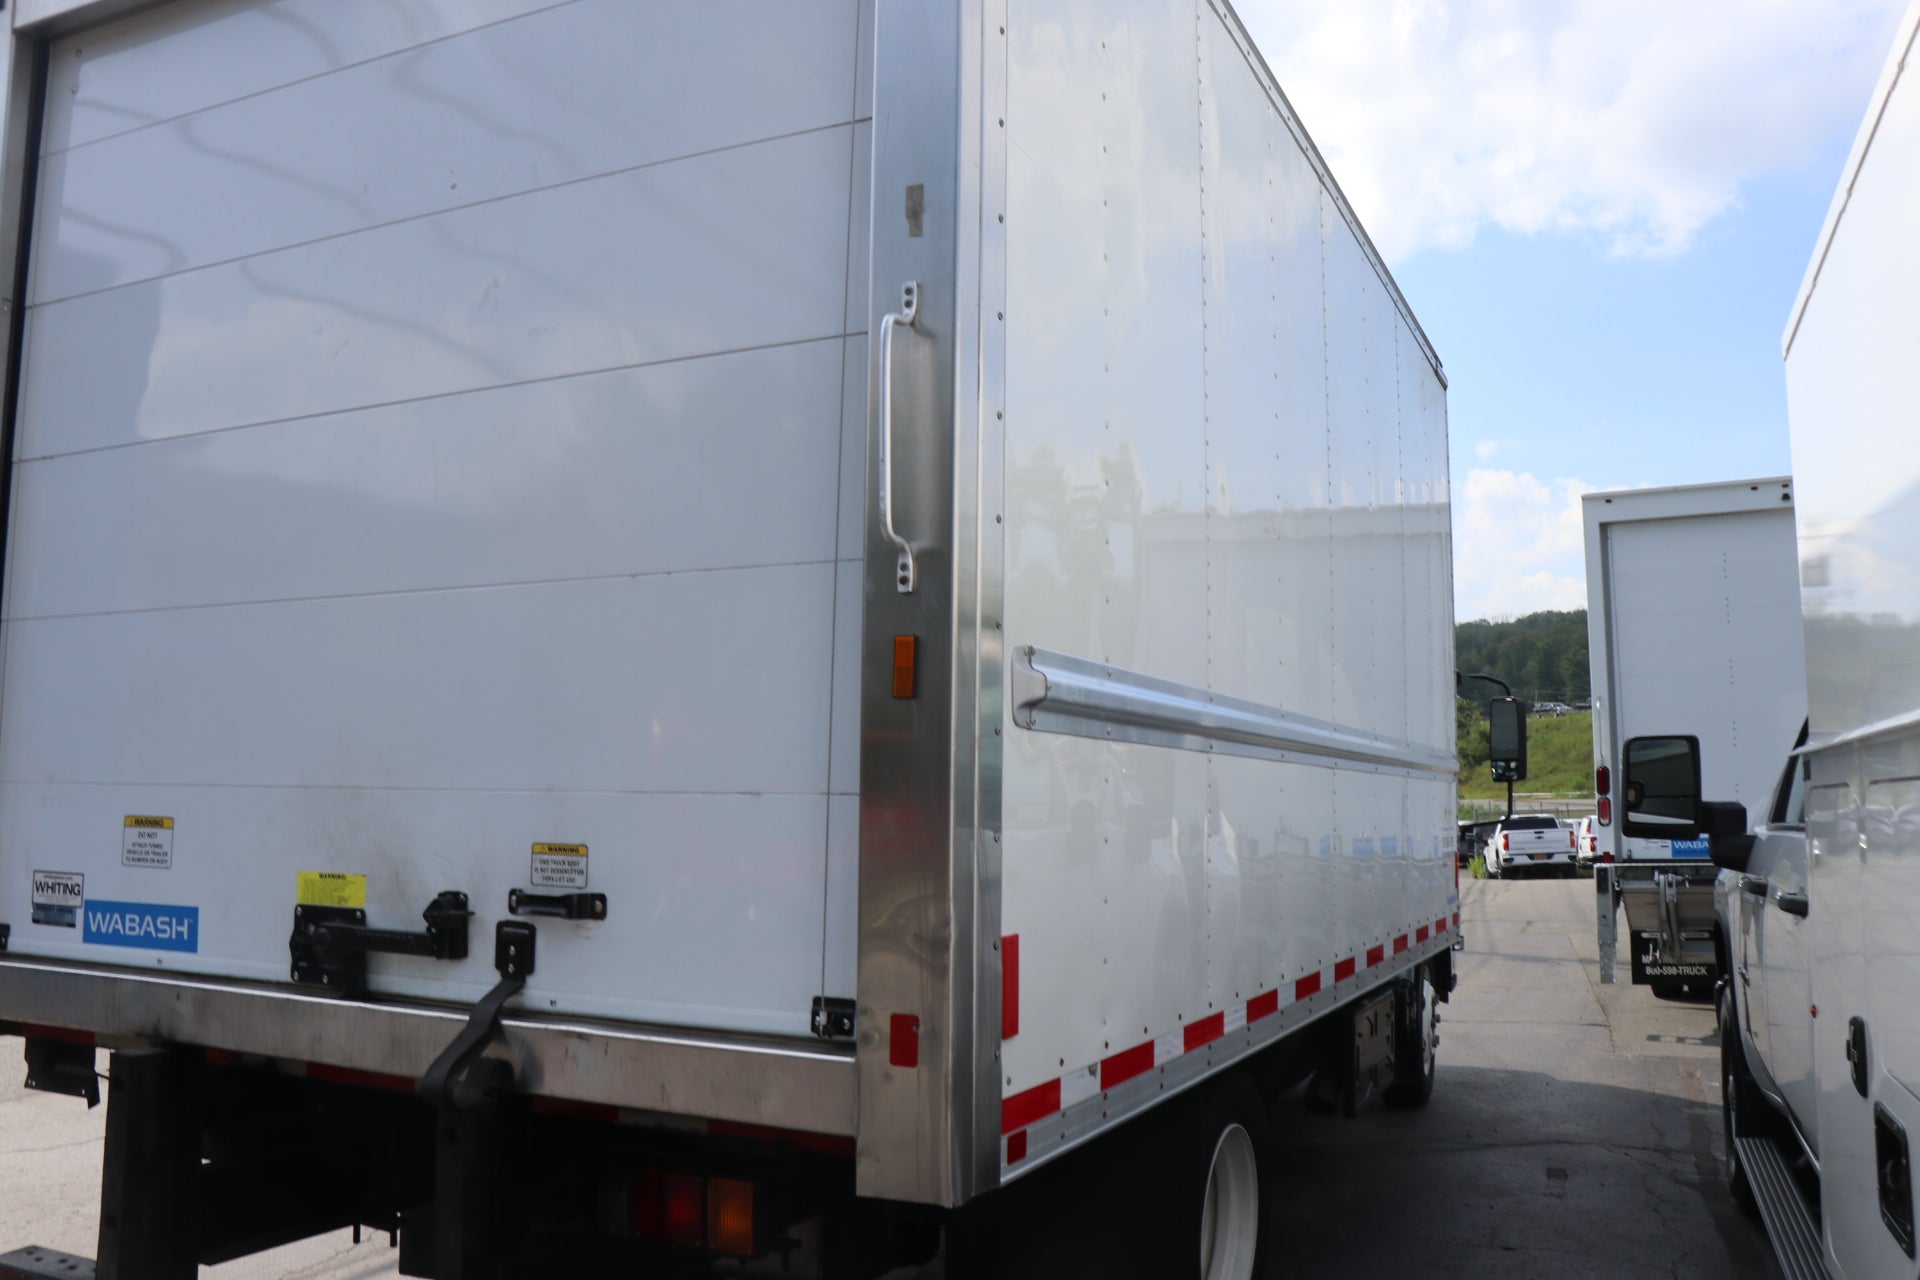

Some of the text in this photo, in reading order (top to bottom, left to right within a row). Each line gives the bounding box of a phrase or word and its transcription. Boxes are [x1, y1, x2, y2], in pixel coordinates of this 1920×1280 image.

[134, 818, 164, 828] WARNING
[147, 831, 158, 840] NOT
[1673, 840, 1709, 849] WABA
[547, 847, 580, 855] WARNING
[318, 872, 346, 880] WARNING
[35, 880, 81, 897] WHITING
[88, 910, 189, 941] WABASH
